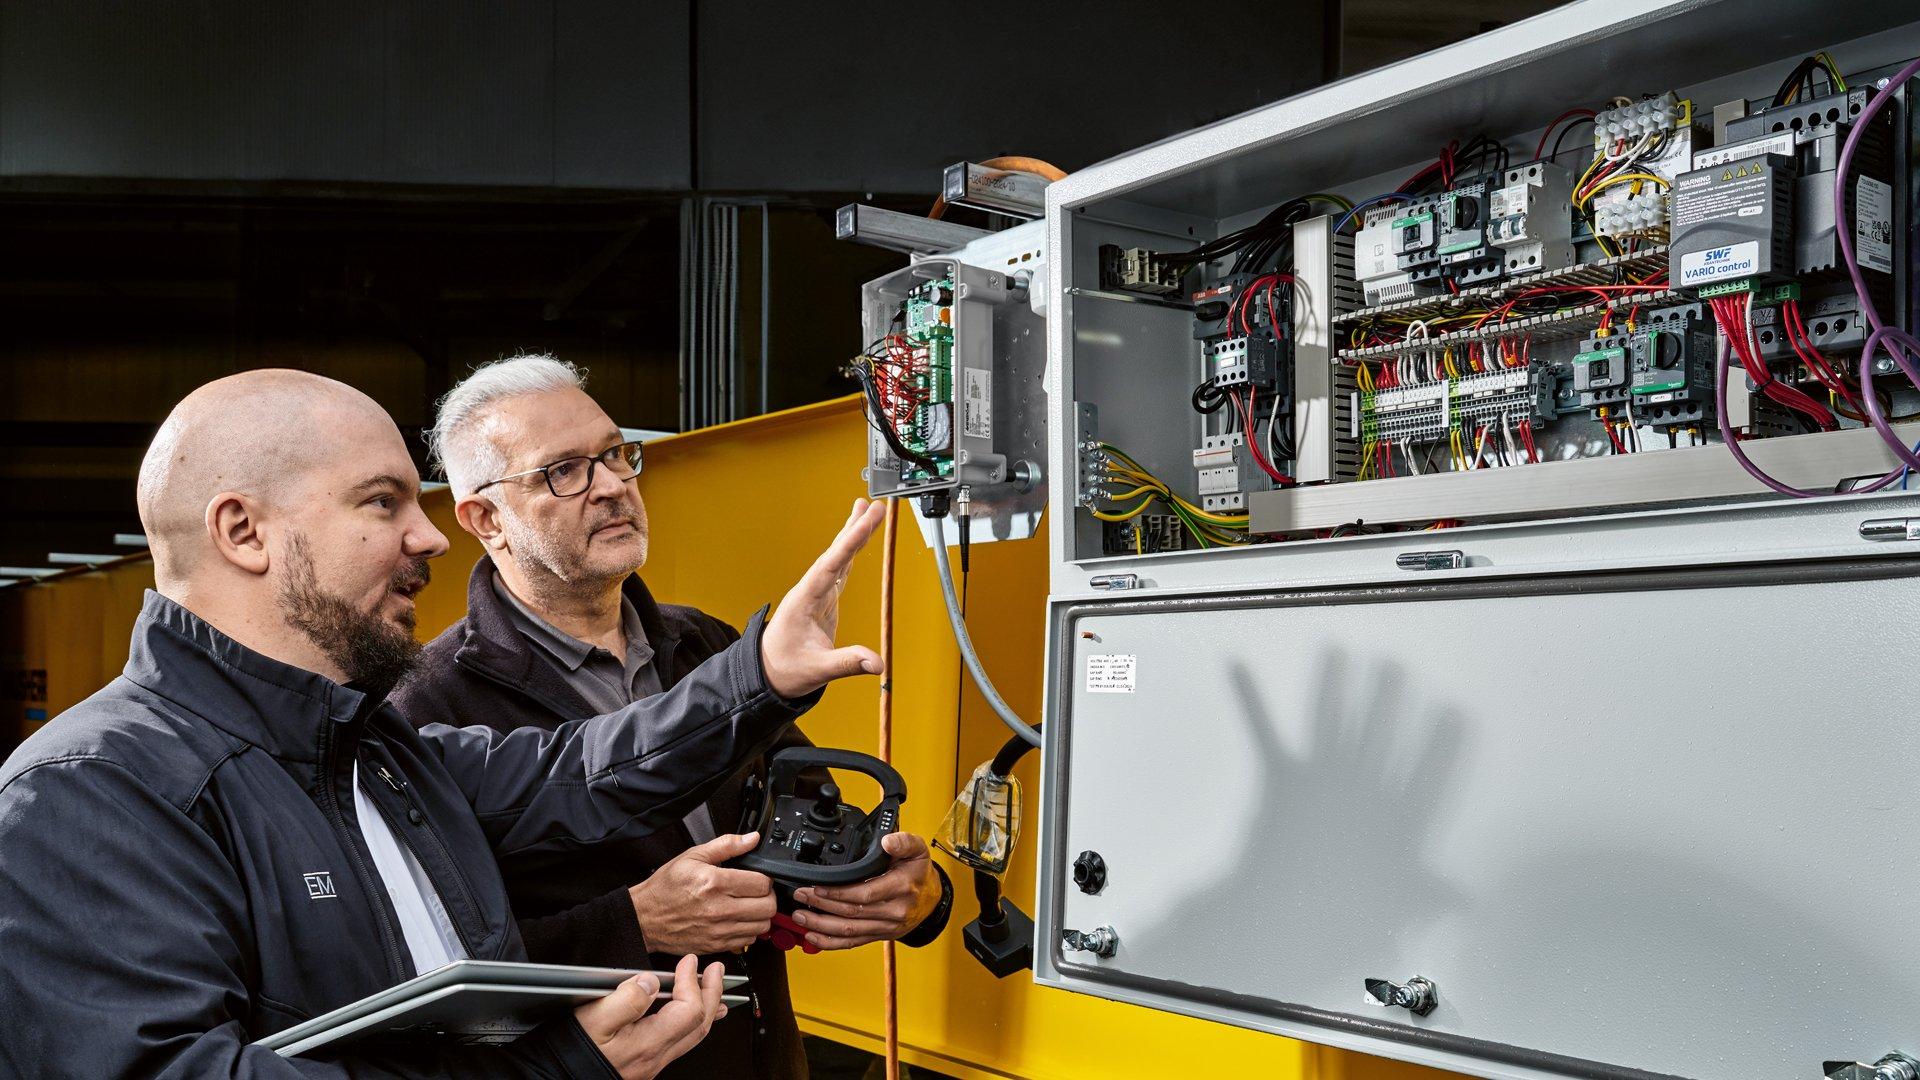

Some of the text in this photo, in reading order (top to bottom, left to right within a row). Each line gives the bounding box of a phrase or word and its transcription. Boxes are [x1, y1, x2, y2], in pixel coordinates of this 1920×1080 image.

[1679, 175, 1711, 188] WARNING
[1705, 247, 1732, 261] SWF
[1685, 265, 1716, 279] VARIO
[1717, 258, 1752, 273] control
[303, 874, 336, 897] EM
